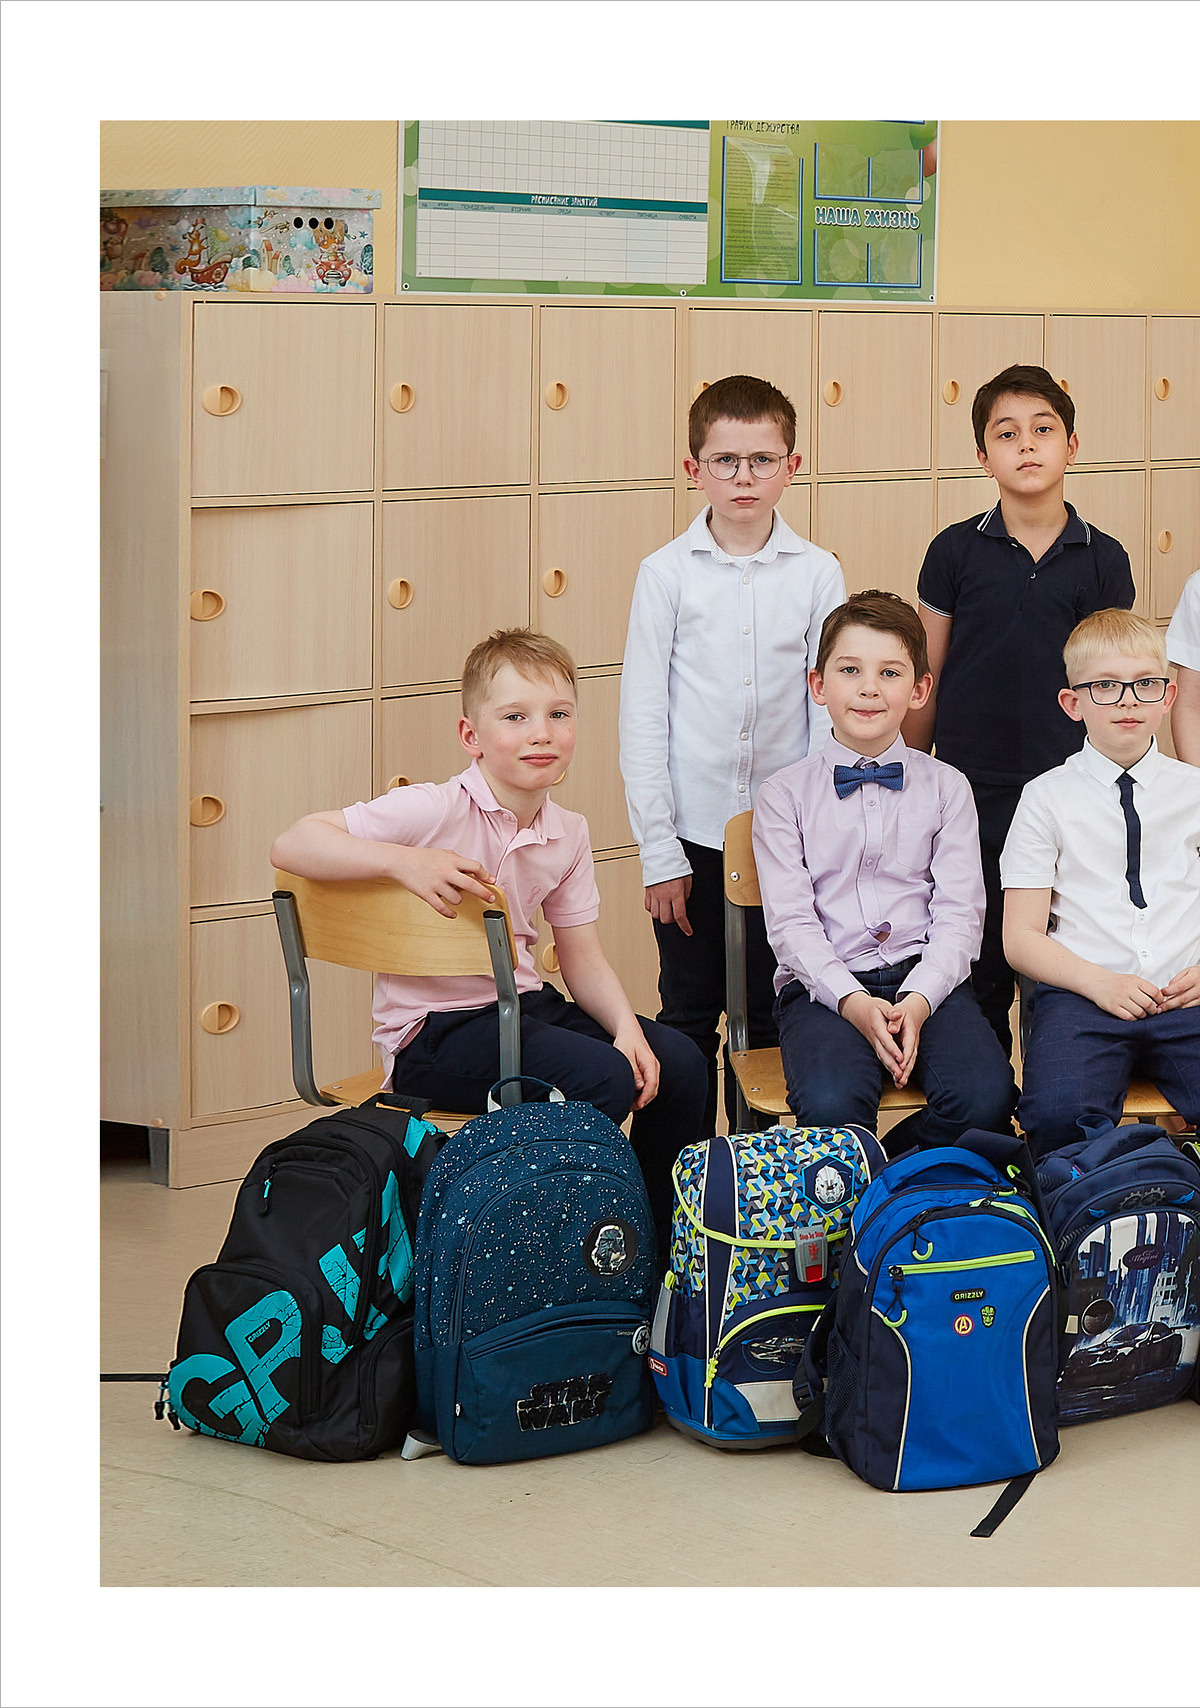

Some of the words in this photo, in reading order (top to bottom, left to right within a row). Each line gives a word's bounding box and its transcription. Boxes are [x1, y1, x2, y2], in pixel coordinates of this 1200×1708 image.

[726, 120, 753, 131] ГРАФИК
[755, 121, 800, 135] ДЕЖУРСТВА
[460, 203, 496, 212] ПОНЕДЕЛЬНИК
[530, 194, 570, 206] РАСПИСАНИЕ
[570, 196, 598, 207] ЗАНЯТИЙ
[814, 206, 861, 226] НАША
[864, 208, 920, 229] ЖИЗНЬ
[954, 1291, 984, 1301] GRIZZLY
[247, 1321, 271, 1343] GRIZZLY
[529, 1372, 614, 1403] STAR
